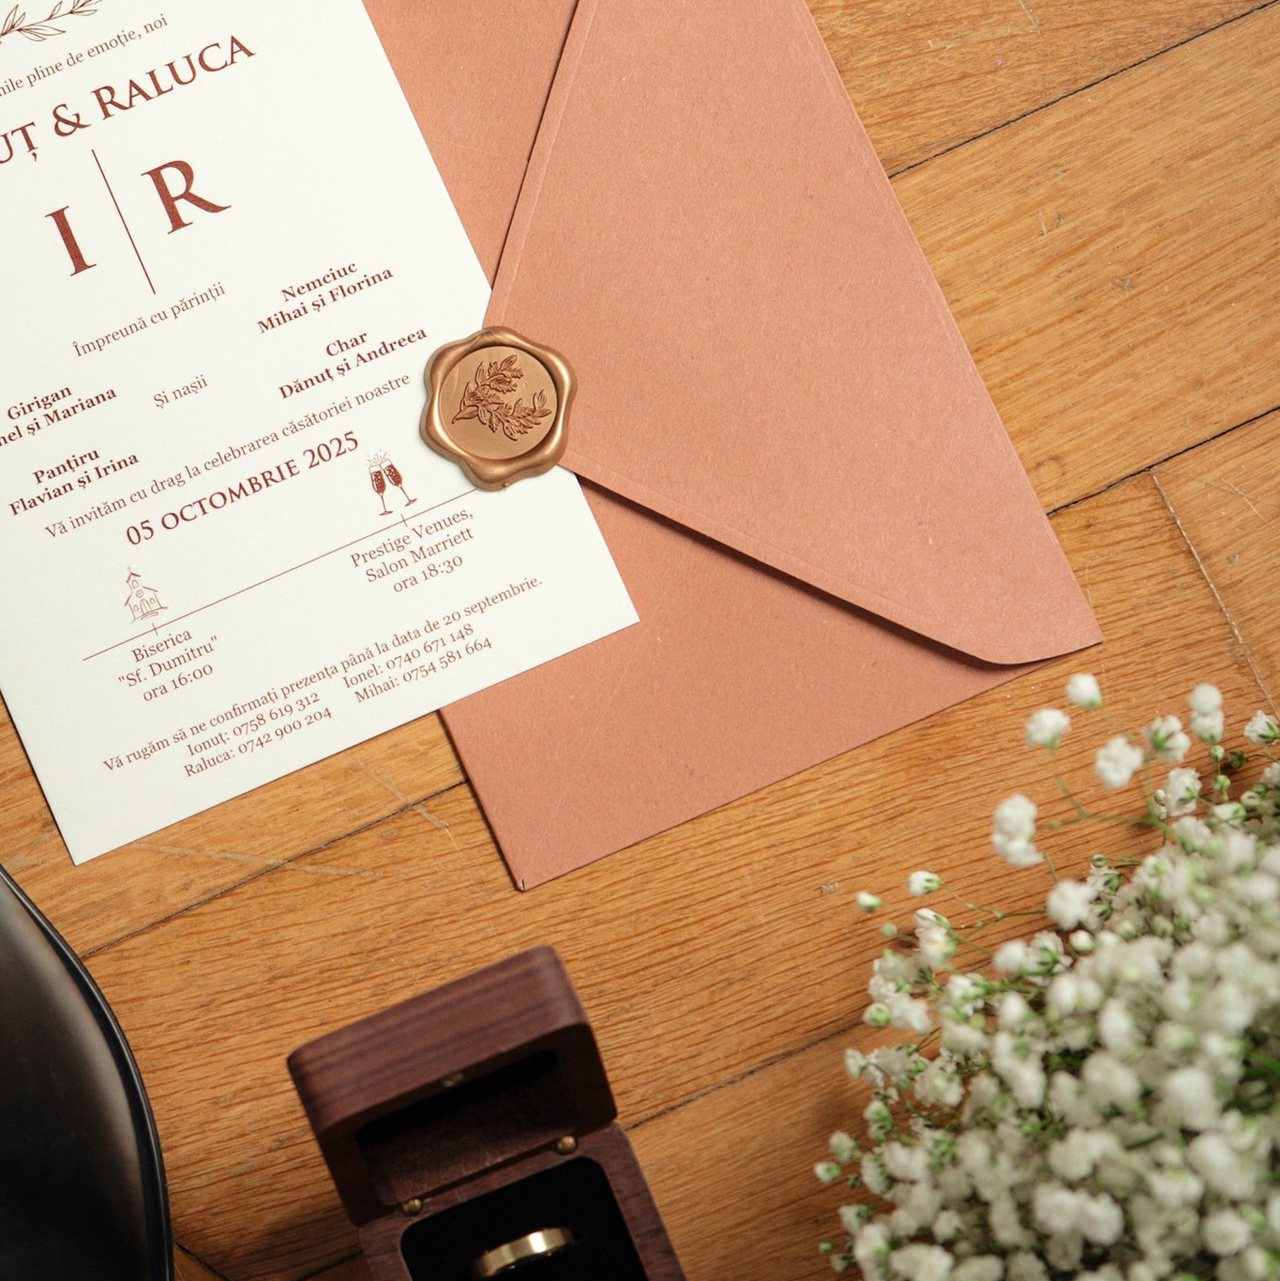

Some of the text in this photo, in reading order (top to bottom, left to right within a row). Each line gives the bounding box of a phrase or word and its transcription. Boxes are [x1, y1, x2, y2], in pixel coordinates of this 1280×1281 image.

[25, 62, 63, 87] pline
[66, 52, 84, 67] de
[143, 13, 168, 34] noi
[51, 103, 92, 137] &
[89, 34, 257, 120] RALUCA
[44, 159, 232, 277] I R
[257, 301, 309, 334] Mihai
[328, 269, 394, 302] Florina
[280, 263, 358, 302] Nemciuc
[72, 316, 148, 357] Împreună
[150, 310, 168, 324] cu
[325, 332, 367, 357] Char
[356, 329, 427, 367] Andreea
[6, 387, 72, 420] Girigan
[42, 389, 117, 426] Mariana
[44, 375, 410, 537] Vă invităm cu drag la celebrarea căsătoriei noastre
[8, 482, 74, 516] Flavian
[93, 454, 139, 479] Irina
[126, 430, 358, 545] 05 OCTOMBRIE 2025
[350, 509, 473, 567] Prestige Venues,
[365, 527, 474, 583] Salon Marriett
[393, 555, 463, 593] ora 18:30
[102, 755, 124, 771] Vă
[126, 738, 170, 763] rugăm
[172, 728, 188, 743] să
[189, 722, 207, 736] ne
[340, 646, 374, 673] până
[374, 642, 390, 654] la
[391, 629, 422, 647] data
[423, 619, 441, 633] de
[442, 611, 461, 626] 20
[463, 577, 542, 616] septembrie.
[117, 635, 217, 687] "Sf. Dumitru"
[131, 630, 192, 663] Biserica
[342, 623, 474, 688] Ionel: 0740 671 148
[354, 637, 492, 703] Mihai: 0754 581 664
[143, 664, 213, 701] ora 16:00
[183, 707, 332, 777] Raluca: 0742 900 204
[232, 713, 266, 736] 0758
[268, 703, 293, 721] 619
[295, 692, 320, 712] 312
